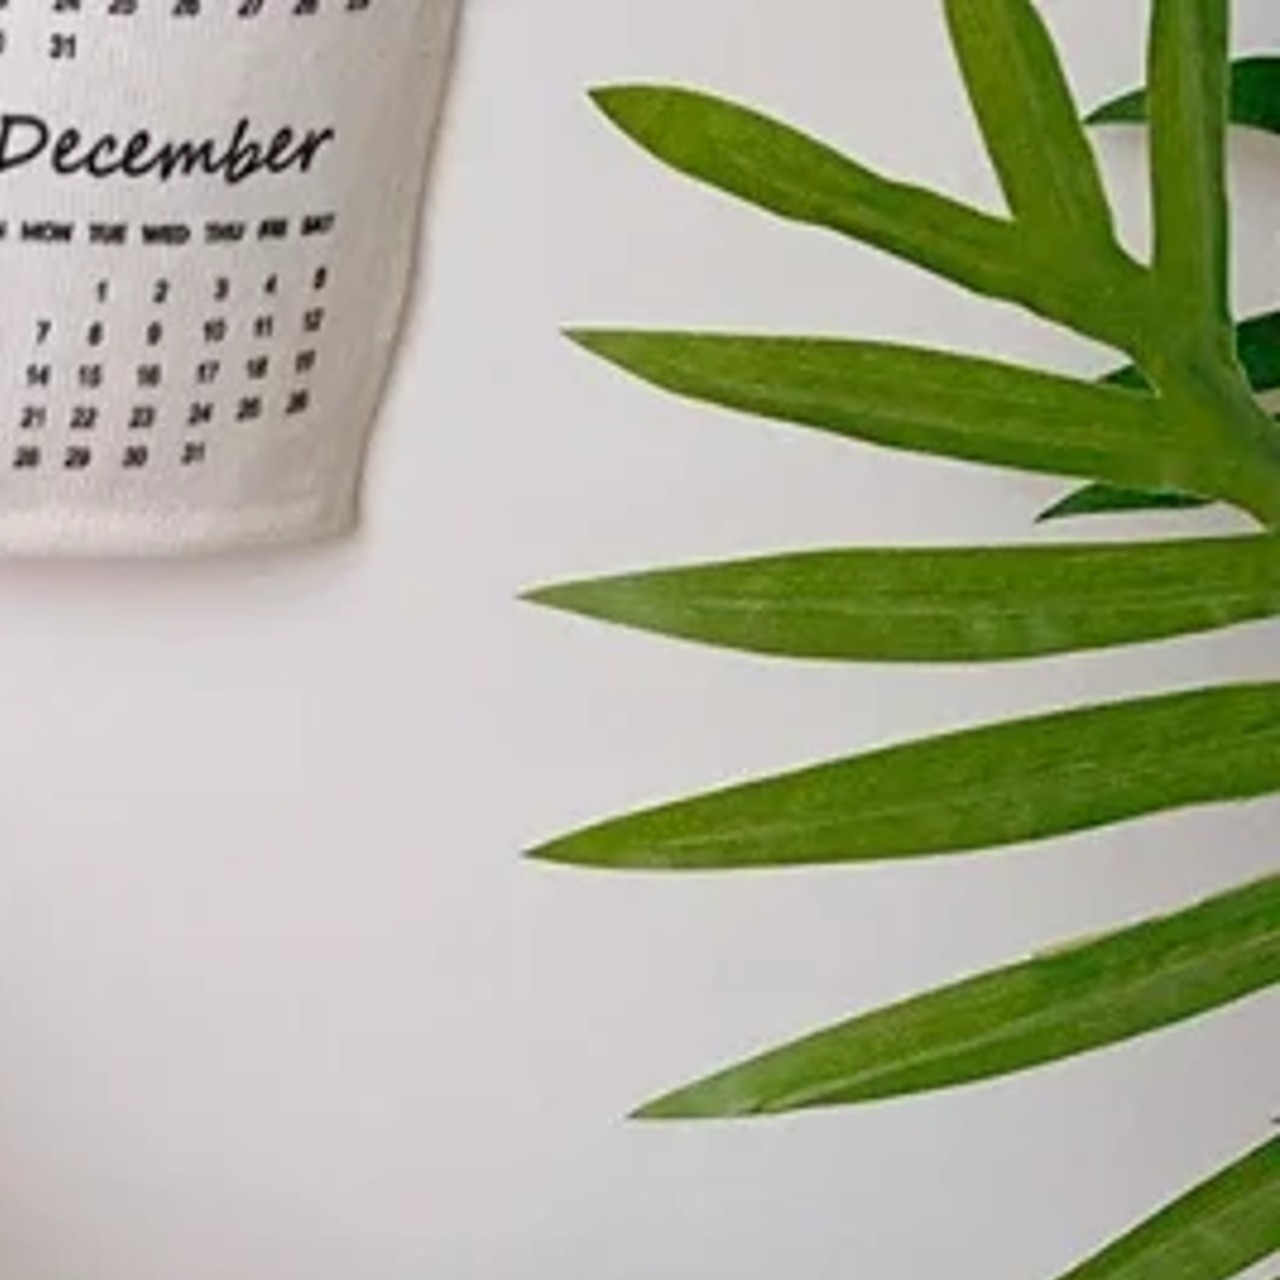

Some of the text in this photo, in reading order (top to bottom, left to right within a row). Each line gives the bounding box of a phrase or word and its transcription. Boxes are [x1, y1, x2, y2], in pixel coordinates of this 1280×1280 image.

[49, 32, 77, 60] 31
[20, 220, 75, 243] MON
[141, 224, 192, 246] WED
[96, 277, 230, 305] 1 2 3
[36, 320, 52, 345] 7
[202, 317, 228, 343] 10
[26, 363, 51, 387] 14
[77, 363, 103, 389] 15
[196, 360, 221, 384] 17
[19, 405, 47, 430] 21
[69, 406, 99, 430] 22
